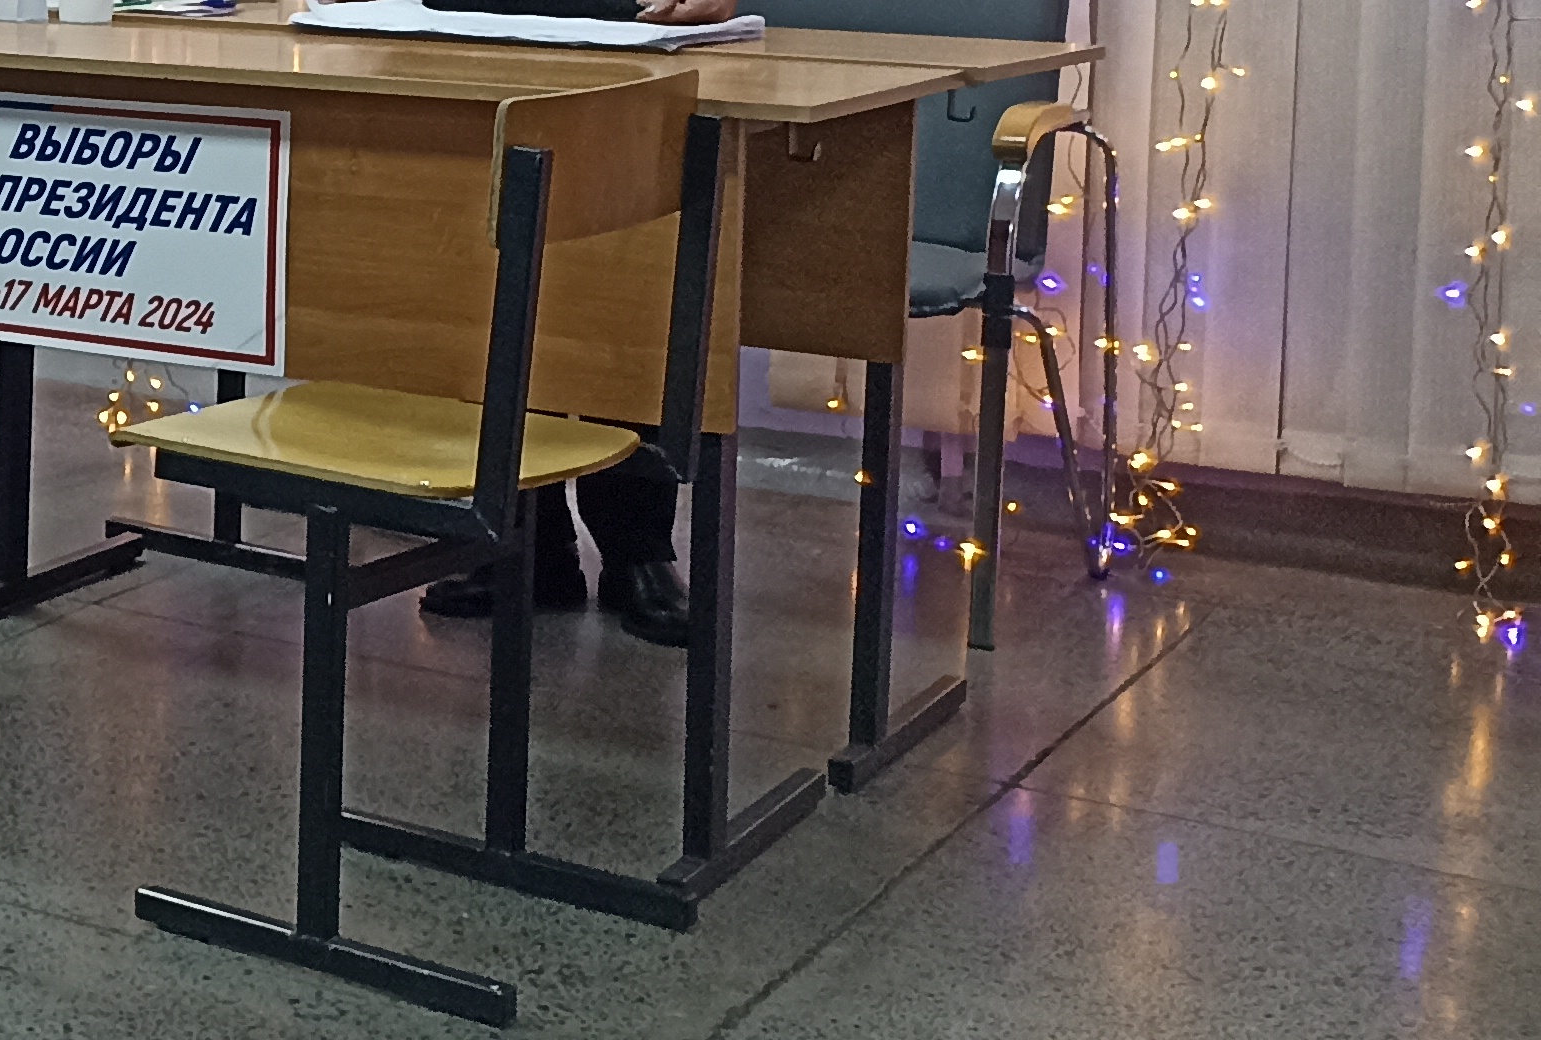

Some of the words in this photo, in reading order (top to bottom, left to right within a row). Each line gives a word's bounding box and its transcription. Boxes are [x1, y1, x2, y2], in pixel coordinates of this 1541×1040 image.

[9, 123, 203, 175] ВЫБОРЫ
[32, 281, 135, 327] МАРТА
[138, 294, 216, 335] 2024
